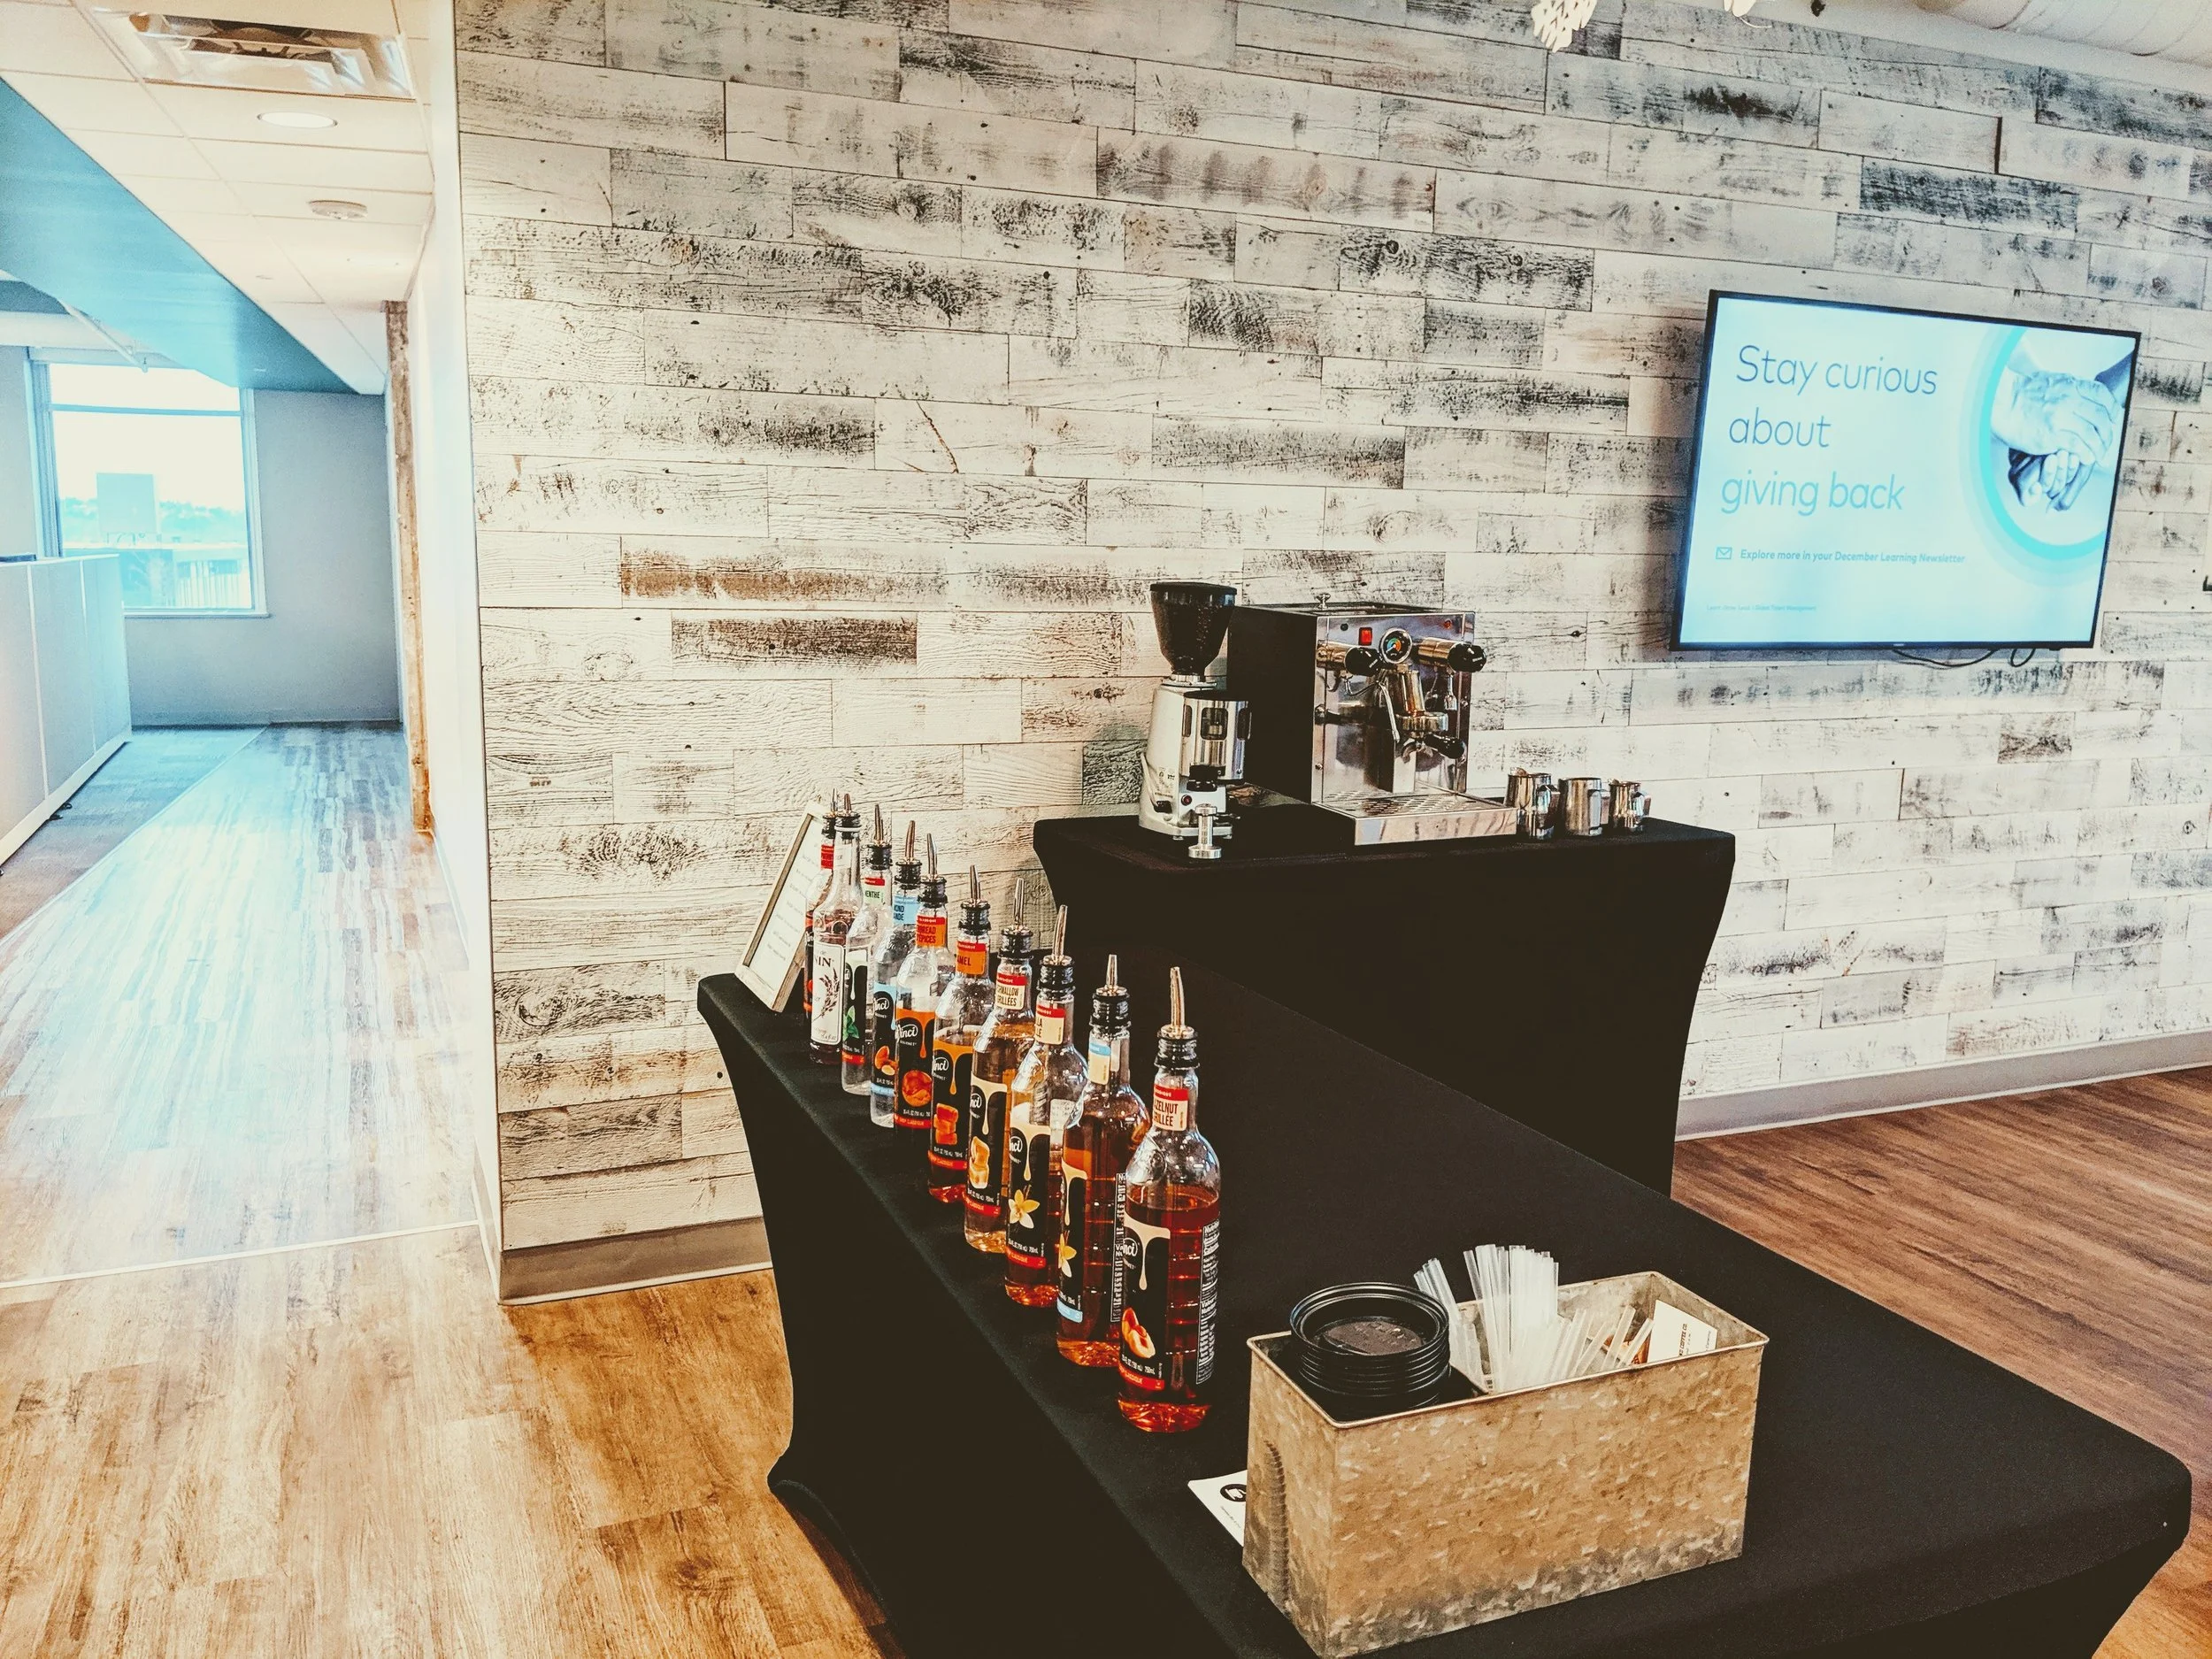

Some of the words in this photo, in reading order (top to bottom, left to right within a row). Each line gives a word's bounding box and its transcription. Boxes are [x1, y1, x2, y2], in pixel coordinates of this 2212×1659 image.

[1736, 345, 1817, 396] Stay
[1825, 357, 1938, 395] curious
[1729, 407, 1831, 448] about
[1721, 469, 1819, 516] giving
[1829, 471, 1905, 510] back
[1740, 549, 1775, 562] Explore
[1802, 550, 1810, 560] in
[1812, 552, 1832, 562] your
[1834, 550, 1878, 562] December
[1880, 551, 1916, 565] Learning
[1918, 553, 1965, 564] Newsletter
